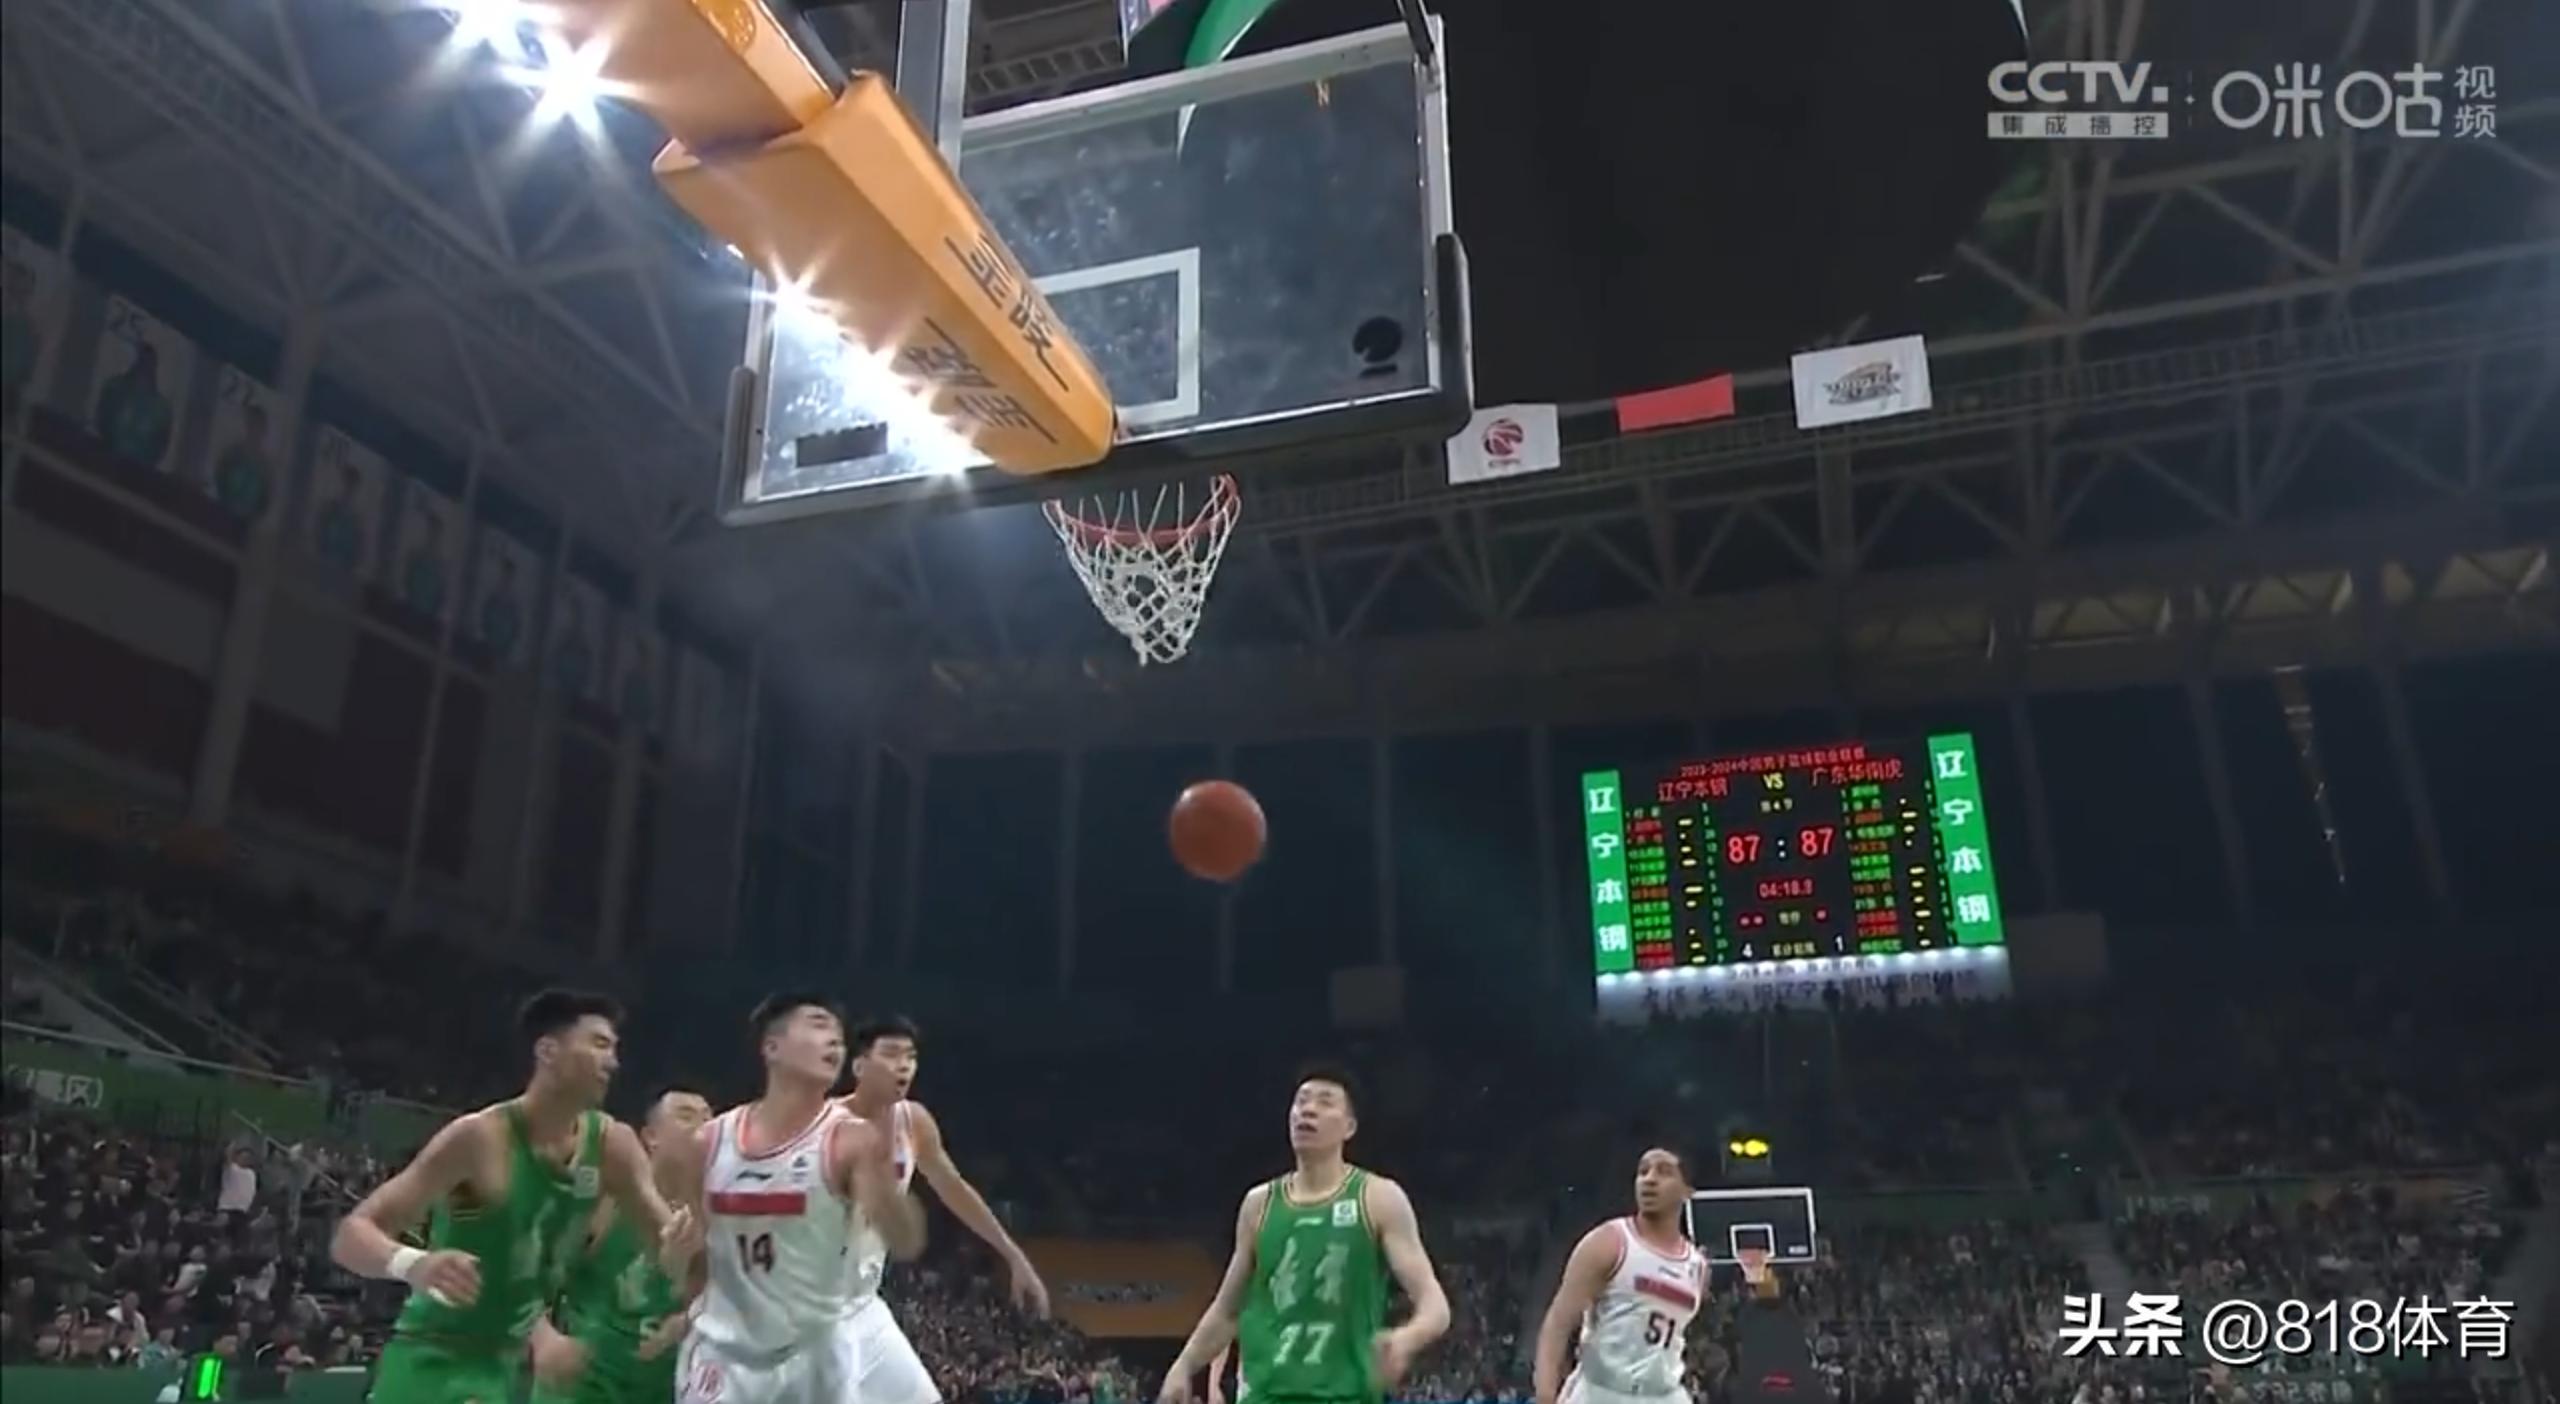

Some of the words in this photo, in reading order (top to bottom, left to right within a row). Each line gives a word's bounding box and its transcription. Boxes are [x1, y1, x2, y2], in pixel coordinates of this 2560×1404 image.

[1762, 772, 1785, 790] VS
[1728, 835, 1760, 864] 87
[1800, 827, 1835, 857] 87
[1937, 750, 1992, 925] 辽宁本钢
[1589, 788, 1628, 953] 辽宁本钢
[1742, 942, 1753, 958] 4
[1835, 935, 1845, 953] 1
[736, 1233, 773, 1273] 14
[1643, 1312, 1676, 1350] 51
